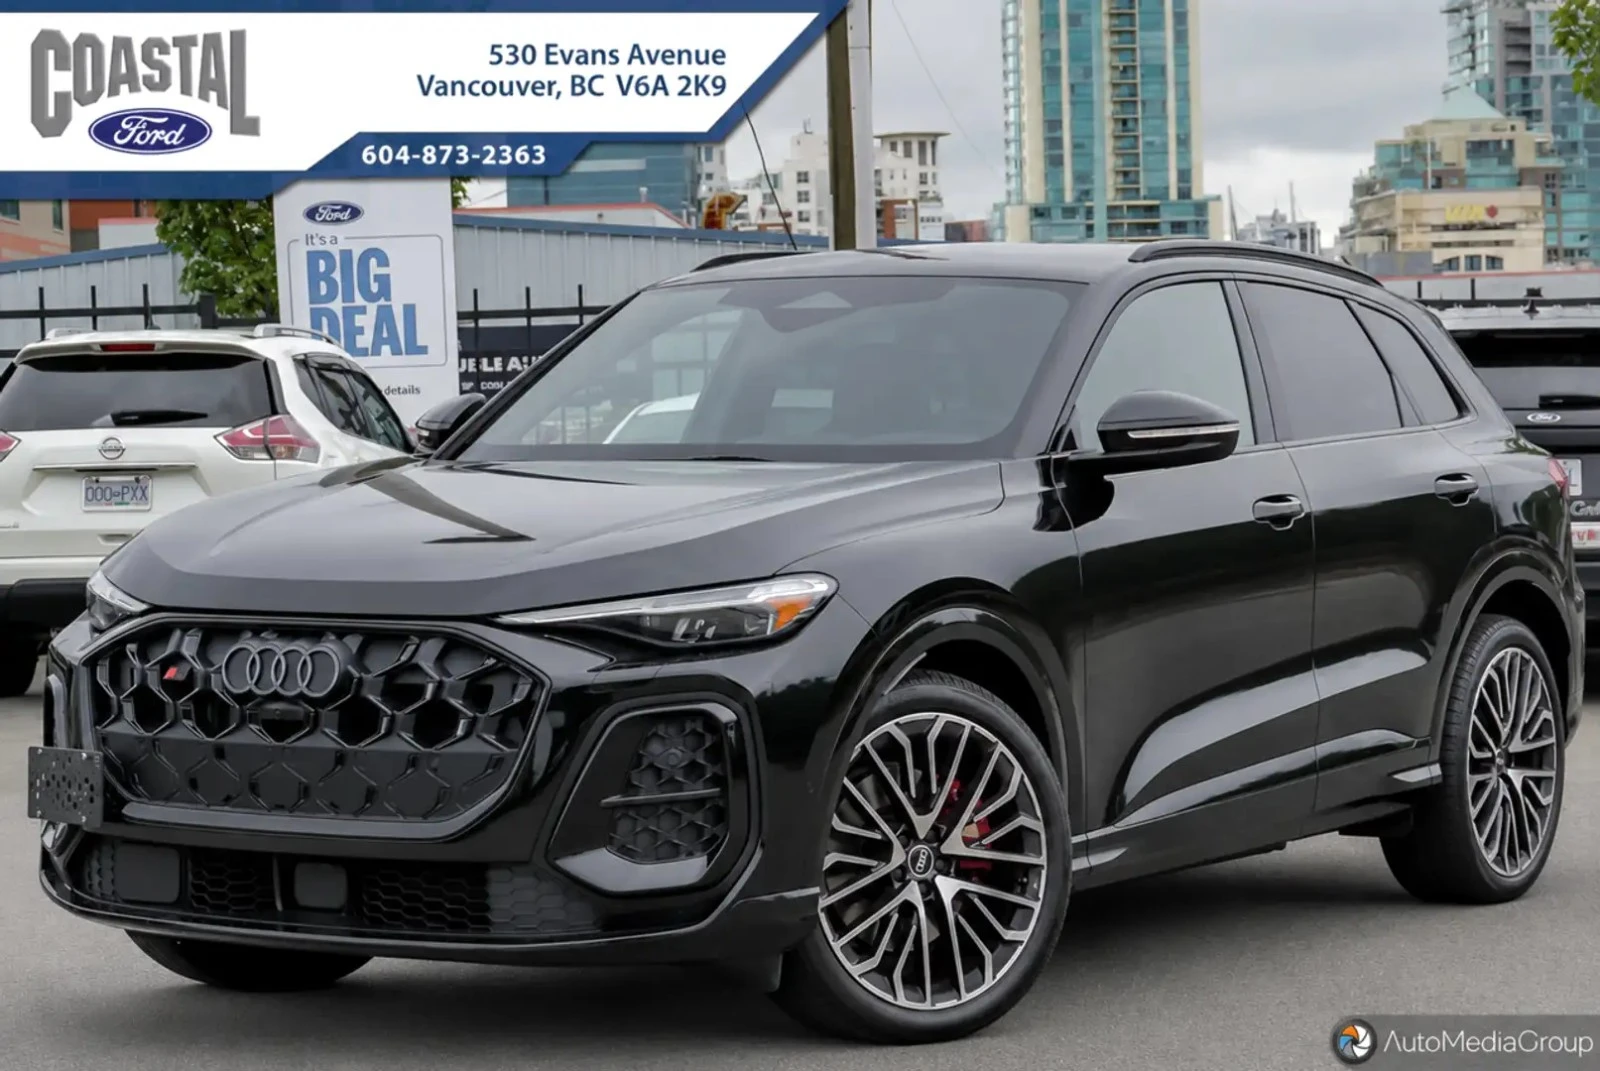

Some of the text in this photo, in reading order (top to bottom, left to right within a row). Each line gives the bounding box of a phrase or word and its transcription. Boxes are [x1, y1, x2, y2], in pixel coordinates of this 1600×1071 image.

[315, 204, 352, 222] Ford
[305, 233, 338, 246] It's a
[306, 247, 392, 305] BIG
[309, 303, 428, 357] DEAL
[384, 385, 421, 396] details
